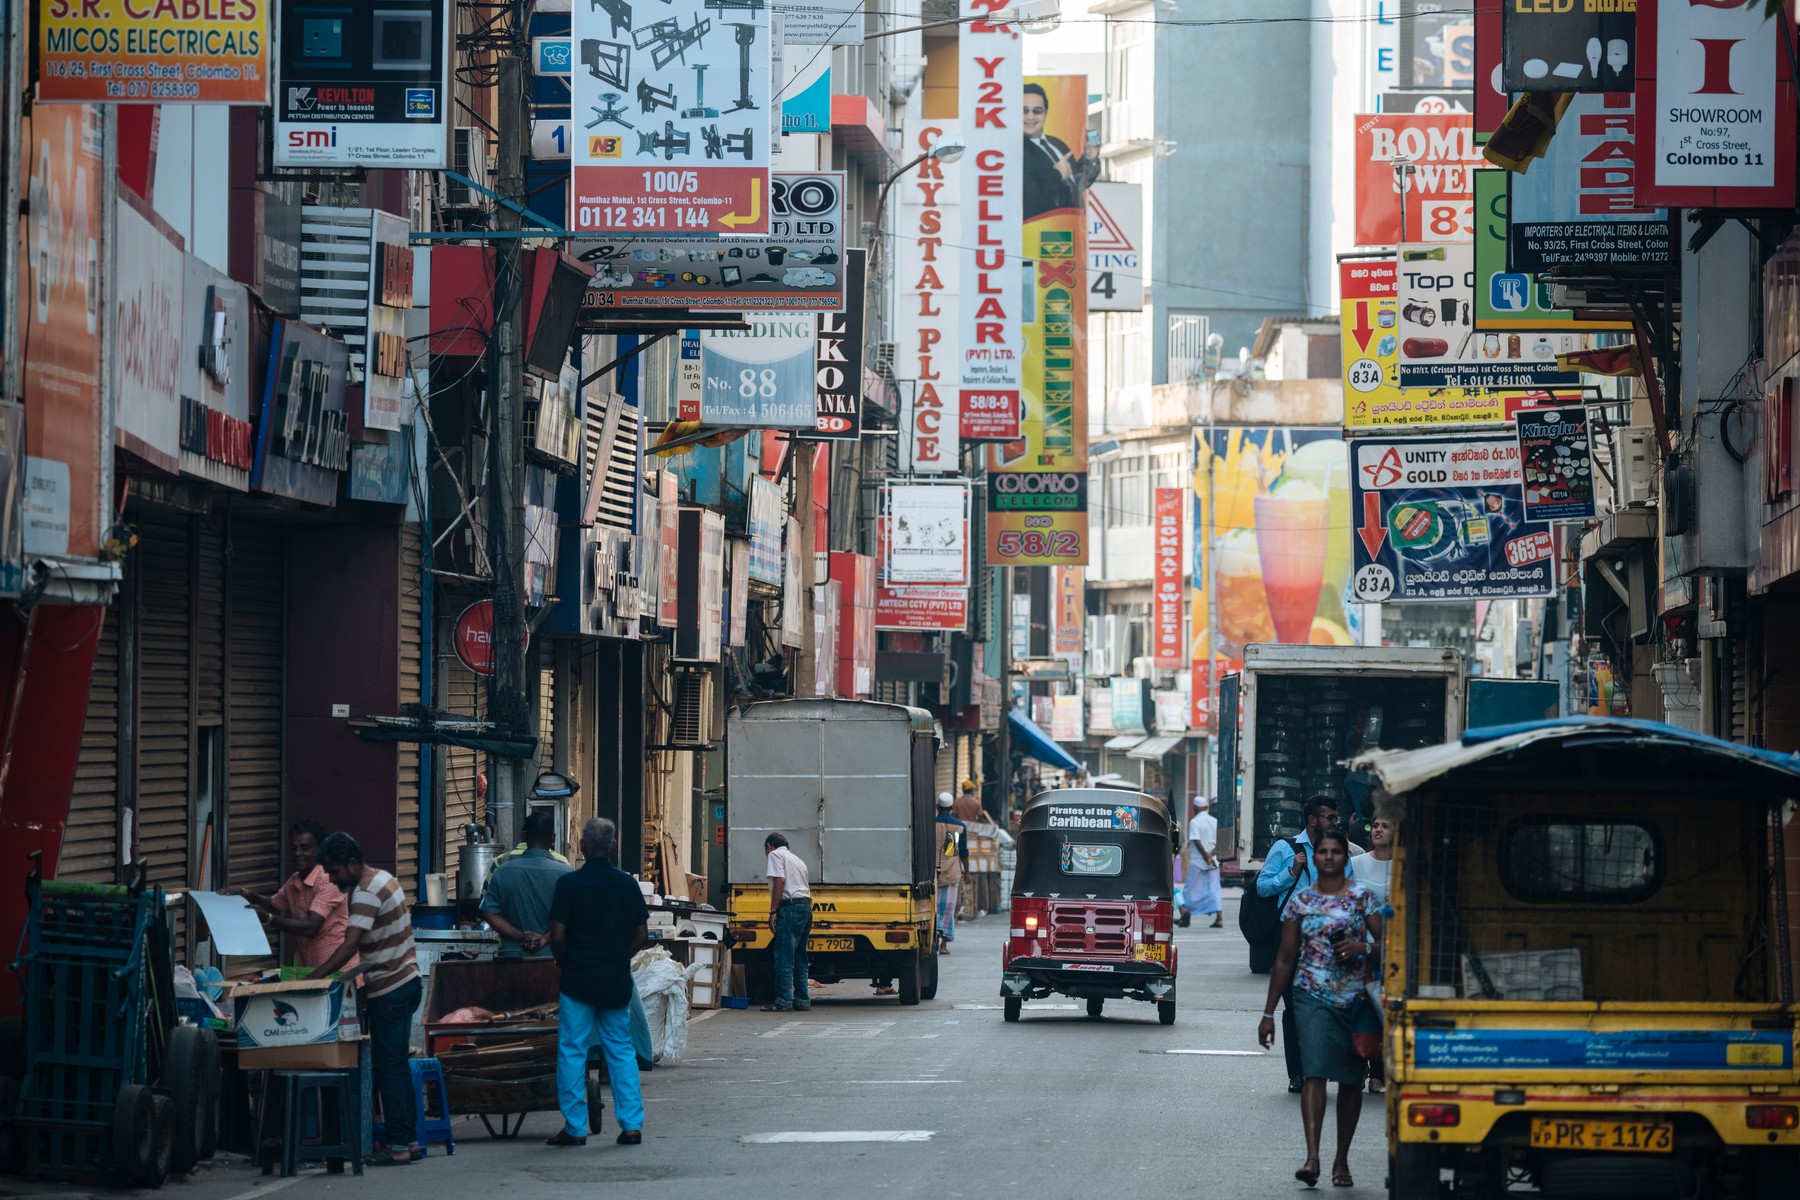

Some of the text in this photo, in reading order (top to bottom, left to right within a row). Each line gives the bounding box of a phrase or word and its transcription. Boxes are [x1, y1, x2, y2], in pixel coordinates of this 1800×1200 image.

[124, 0, 256, 20] CABLES
[47, 28, 259, 55] MICOS ELECTRICALS
[47, 62, 259, 80] 116/25, First Cross Street, Colombo 11.
[107, 82, 198, 96] Tel: 077 8258390
[317, 88, 375, 103] KEVILTON
[804, 114, 818, 127] 11.
[1669, 108, 1762, 123] SHOWROOM
[1358, 116, 1380, 134] FIRST
[288, 126, 336, 147] smi
[1700, 127, 1730, 138] No:97,
[1679, 136, 1751, 151] 1st Cross Street,
[1666, 153, 1764, 166] Colombo 11
[643, 171, 698, 193] 100/5
[580, 196, 610, 204] Mumthaz
[612, 196, 635, 205] Mahal,
[669, 197, 691, 205] Street,
[692, 197, 732, 205] Colombo-11
[973, 57, 1007, 344] Y2K CELLULAR
[580, 207, 709, 228] 0112 341 144
[796, 222, 834, 235] LTD
[1524, 225, 1637, 238] IMPORTERS OF ELECTRICAL ITEMS
[1528, 240, 1644, 251] No. 93/25, First Cross Street,
[1541, 254, 1573, 263] Tel/Fax:
[1575, 253, 1608, 262] 2439397
[1610, 253, 1640, 262] Mobile:
[1091, 272, 1116, 299] 4
[1403, 273, 1454, 291] Top
[686, 298, 702, 306] Street,
[708, 322, 809, 338] TRADING
[965, 349, 1015, 361] (PVT) LTD.
[1352, 370, 1379, 384] 83A
[1412, 366, 1429, 374] 87/17,
[1430, 366, 1456, 375] (Cristal
[1458, 365, 1479, 373] Plaza)
[707, 369, 777, 397] No. 88
[1445, 375, 1534, 386] Tel 0112 451100.
[915, 328, 943, 462] PLACE
[970, 396, 1008, 409] 58/8-9
[704, 404, 811, 418] Tel/Fax 4 506465
[1521, 420, 1587, 439] Kinglux
[1405, 451, 1447, 463] UNITY
[995, 474, 1079, 493] COLOMBO
[1407, 470, 1447, 483] GOLD
[1001, 496, 1075, 505] TELECOM
[1025, 516, 1053, 527] NO
[998, 530, 1080, 557] 58/2
[1160, 516, 1177, 577] BOMBAY
[1534, 534, 1549, 545] Days
[1508, 537, 1537, 565] 365
[1537, 546, 1552, 557] Open
[1369, 567, 1382, 575] No
[902, 588, 939, 596] Authorised
[1359, 578, 1390, 592] 83A
[929, 601, 947, 610] (PVT)
[1158, 582, 1181, 644] SWEETS
[1049, 807, 1084, 815] Pirates
[1049, 815, 1112, 829] Caribbean
[264, 1027, 309, 1037] CMI orchards
[1612, 1125, 1671, 1148] 1173
